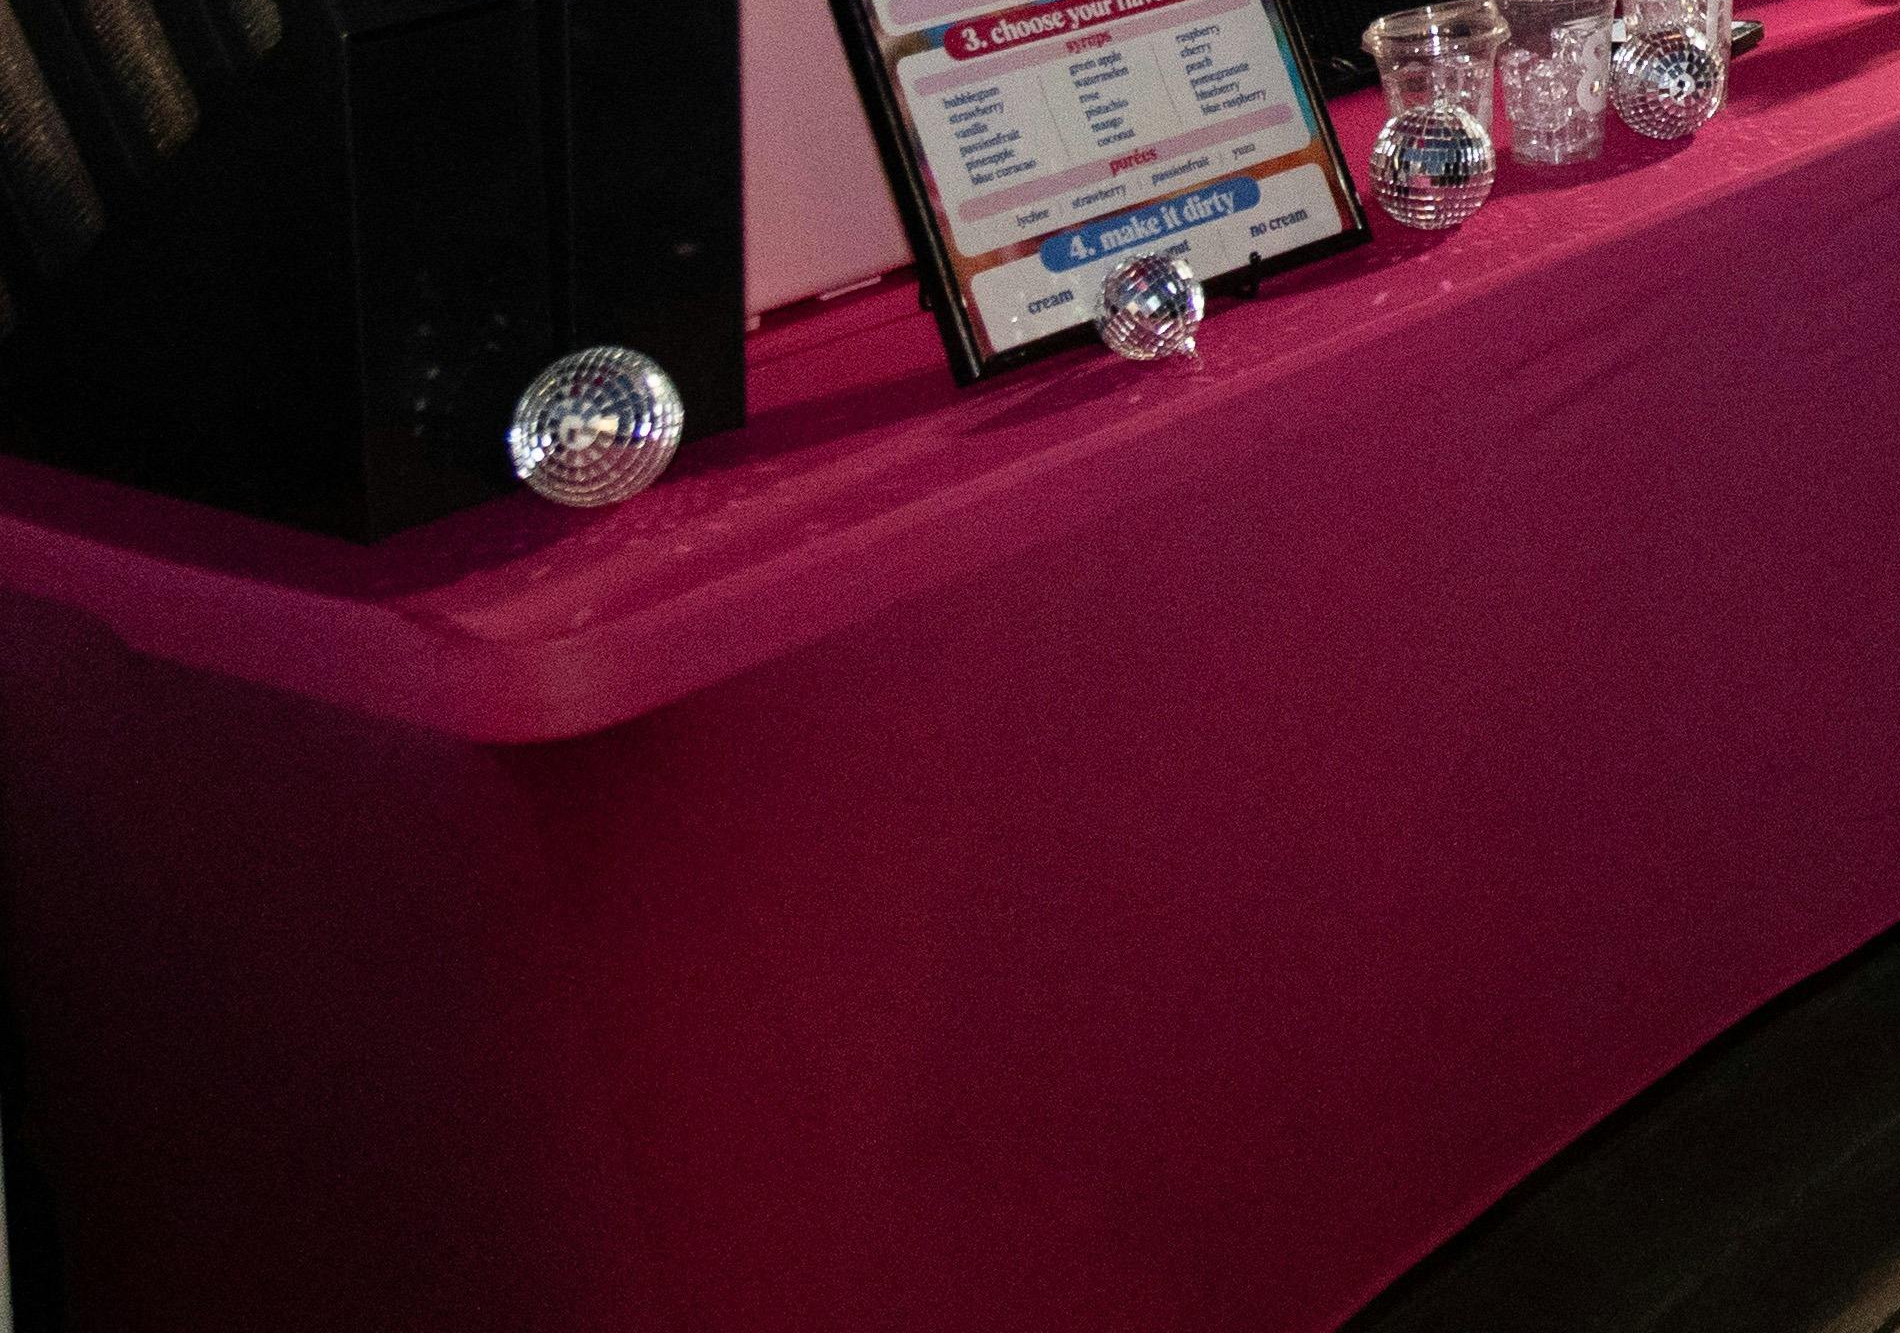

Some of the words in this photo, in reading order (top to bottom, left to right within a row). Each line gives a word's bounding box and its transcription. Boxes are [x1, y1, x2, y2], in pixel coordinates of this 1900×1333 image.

[962, 28, 987, 52] 3.
[991, 13, 1066, 44] choose
[1068, 0, 1112, 30] your
[1069, 236, 1096, 260] 4.
[1100, 214, 1163, 250] make
[1160, 204, 1181, 230] it
[1182, 189, 1236, 221] dirty
[1250, 224, 1267, 237] no
[1269, 209, 1308, 233] cream
[1028, 288, 1074, 314] cream
